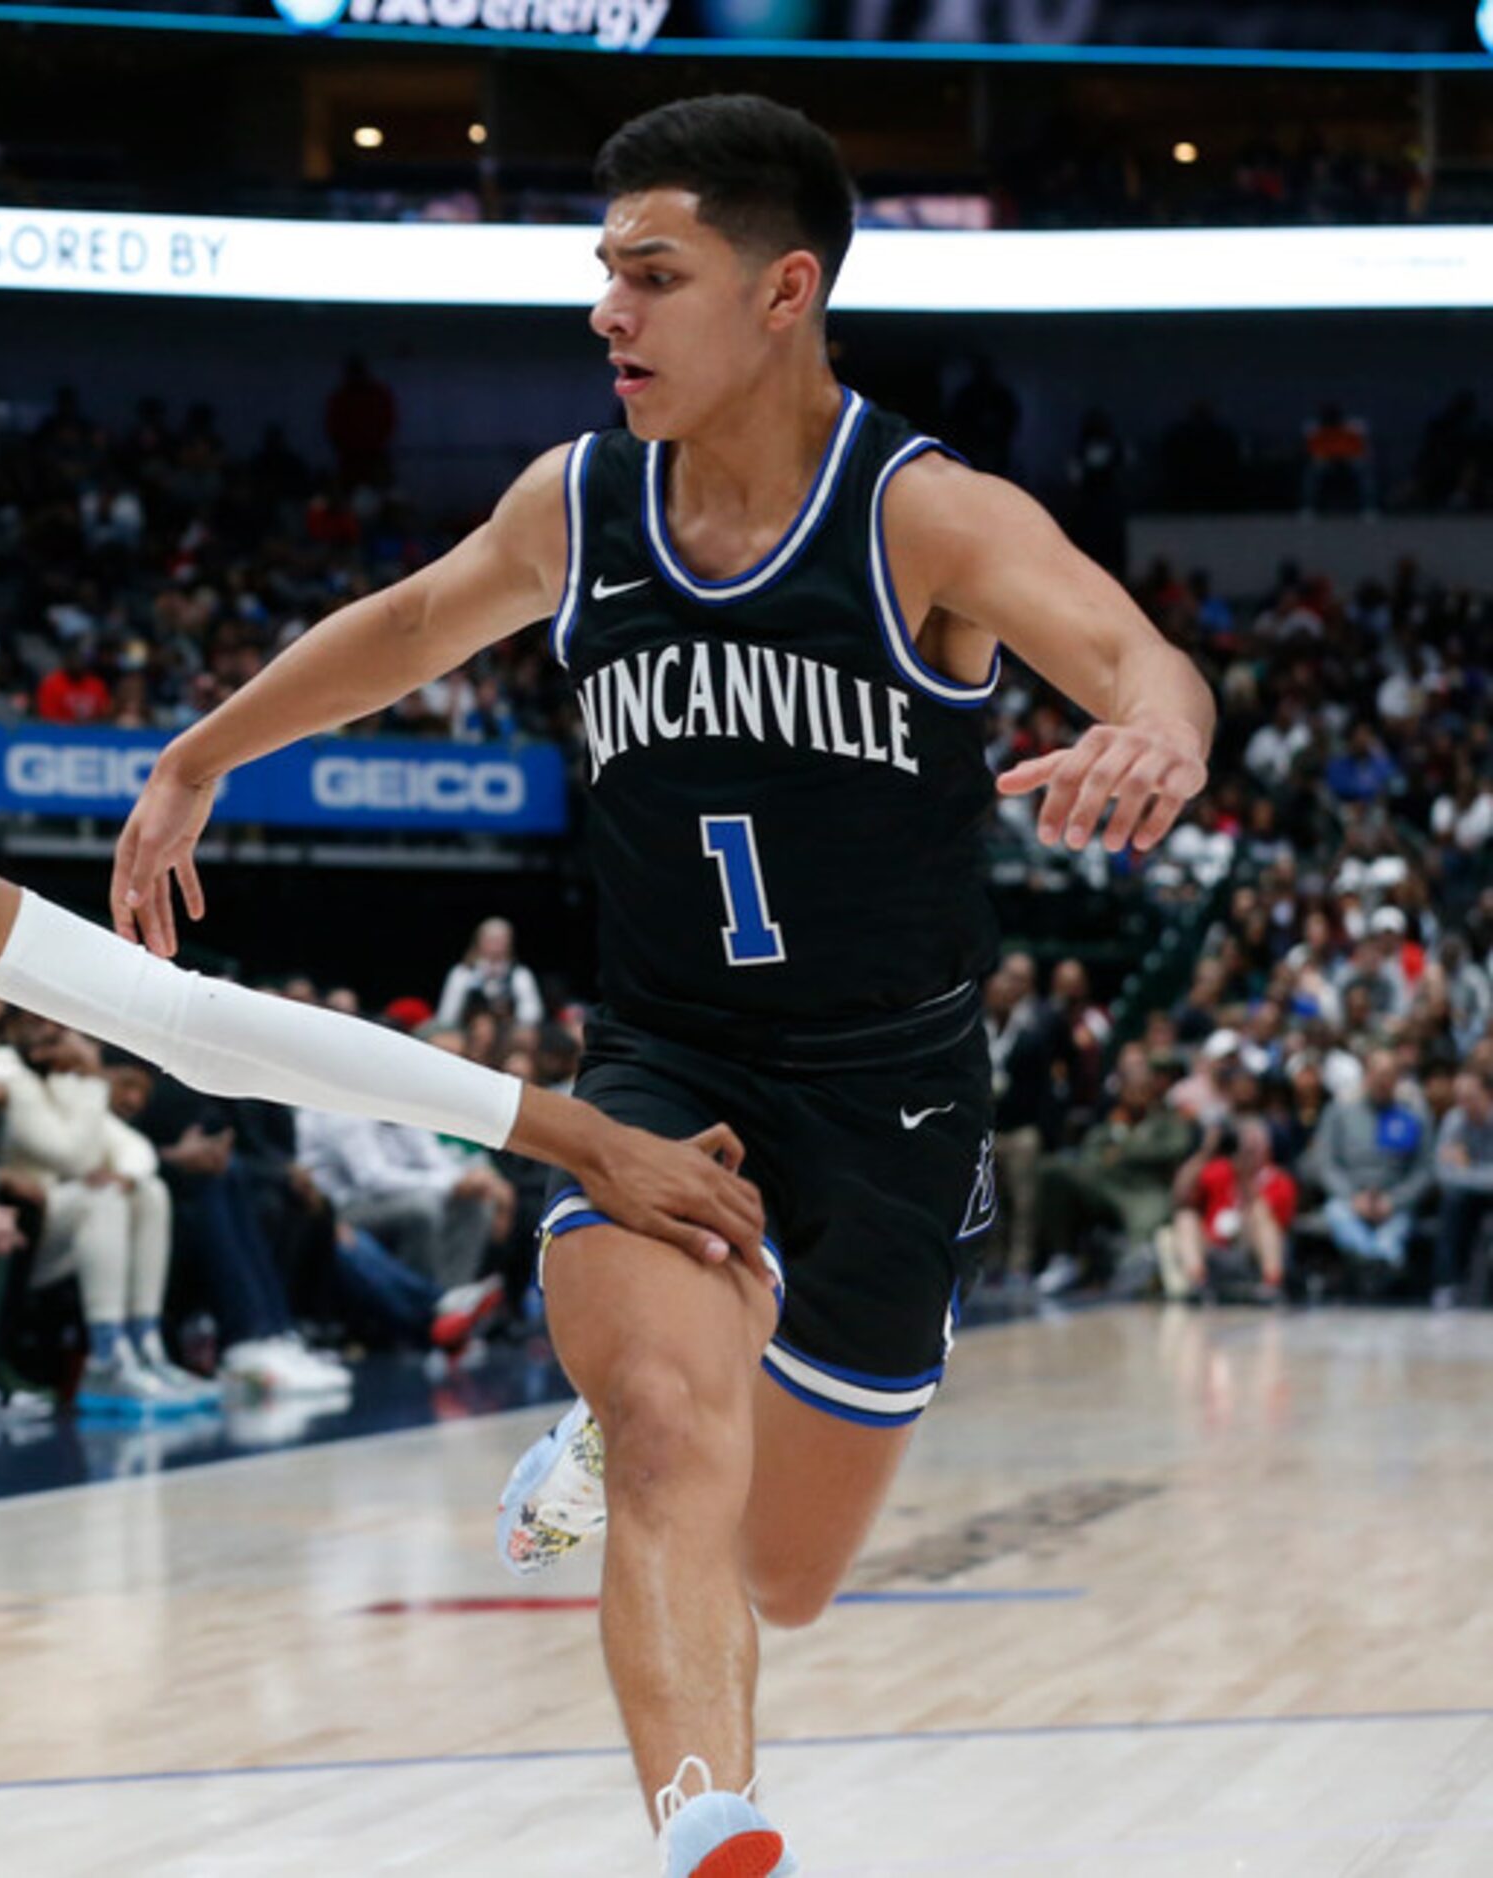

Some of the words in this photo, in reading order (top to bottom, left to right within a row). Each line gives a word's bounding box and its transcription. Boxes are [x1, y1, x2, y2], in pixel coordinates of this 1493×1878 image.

[170, 231, 227, 277] BY
[6, 743, 227, 800] GEIC
[311, 756, 526, 814] GEICO
[699, 814, 787, 967] 1
